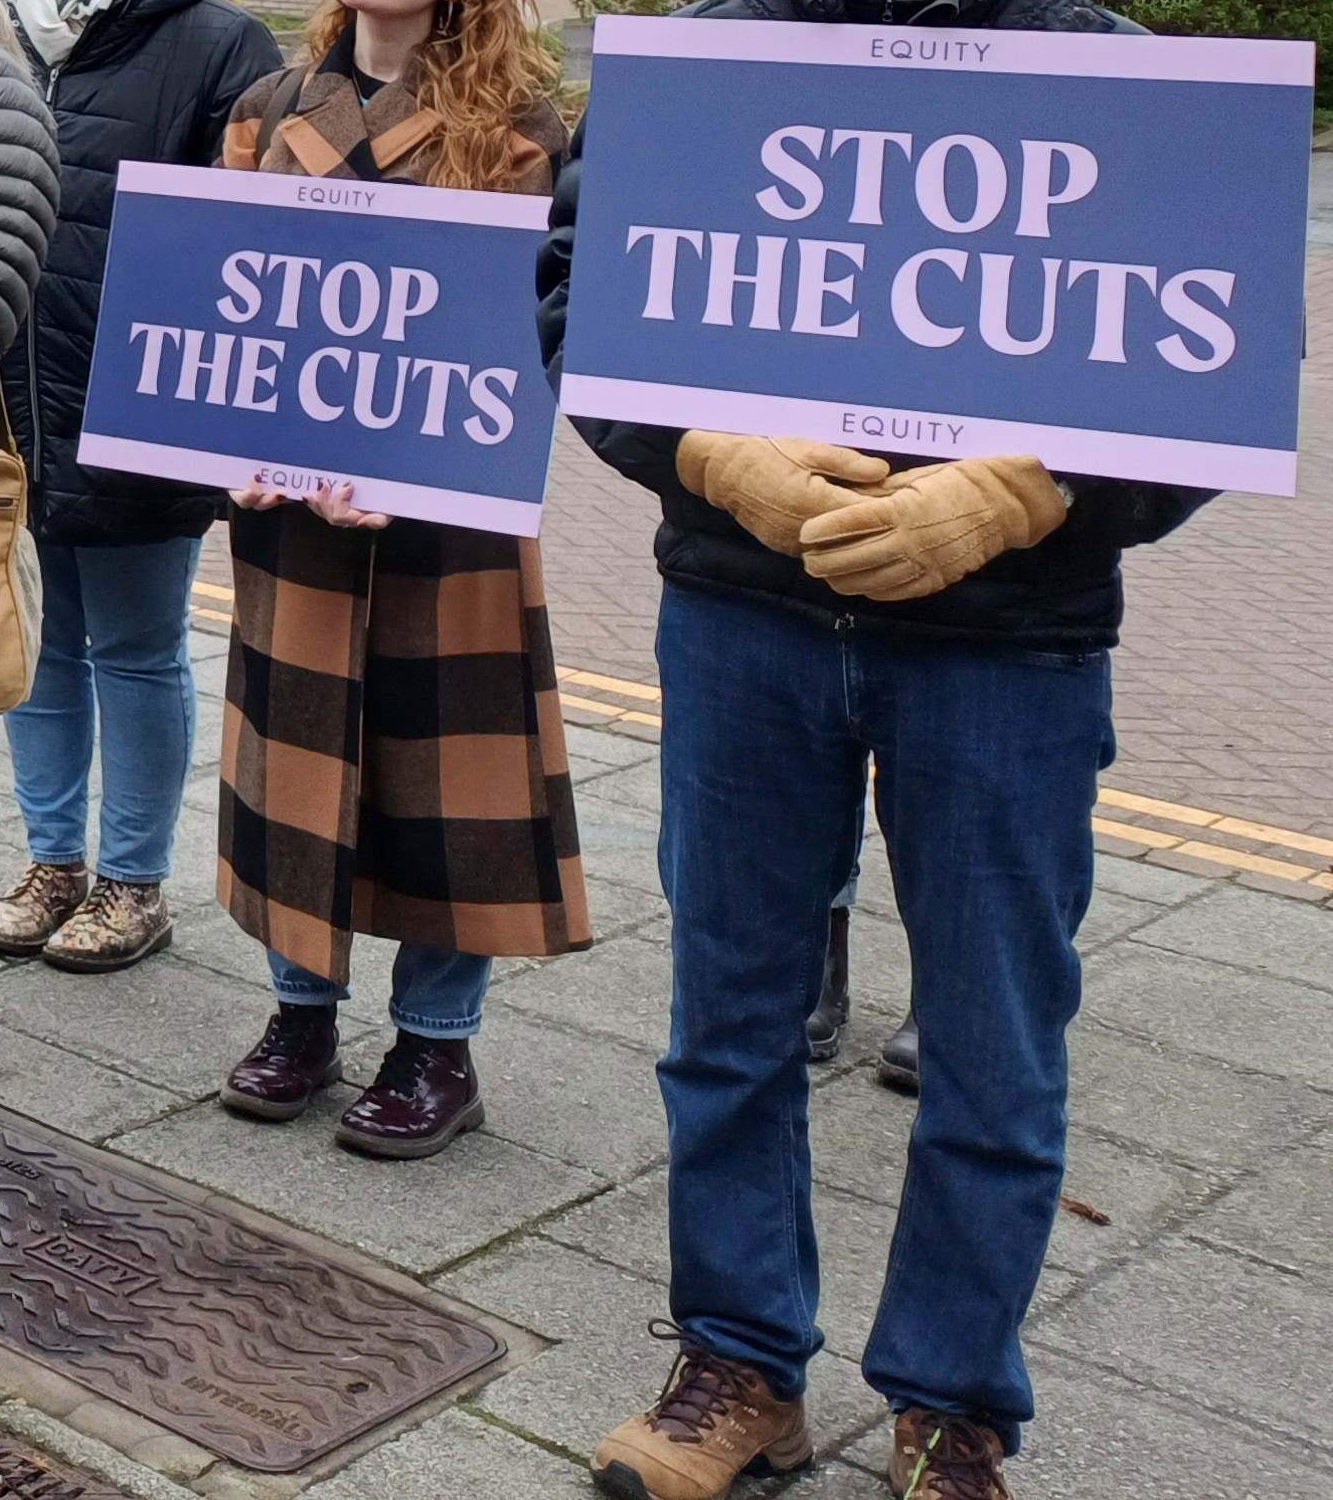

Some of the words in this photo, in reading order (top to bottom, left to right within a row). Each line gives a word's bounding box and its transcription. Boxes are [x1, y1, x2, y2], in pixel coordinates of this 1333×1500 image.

[870, 38, 993, 63] EQUITY
[297, 186, 377, 208] EQUITY
[756, 124, 1099, 238] STOP
[216, 249, 439, 342] STOP
[625, 224, 866, 339] THE
[890, 247, 1237, 373] CUTS
[129, 322, 286, 413] THE
[298, 346, 519, 446] CUTS
[841, 412, 966, 446] EQUITY
